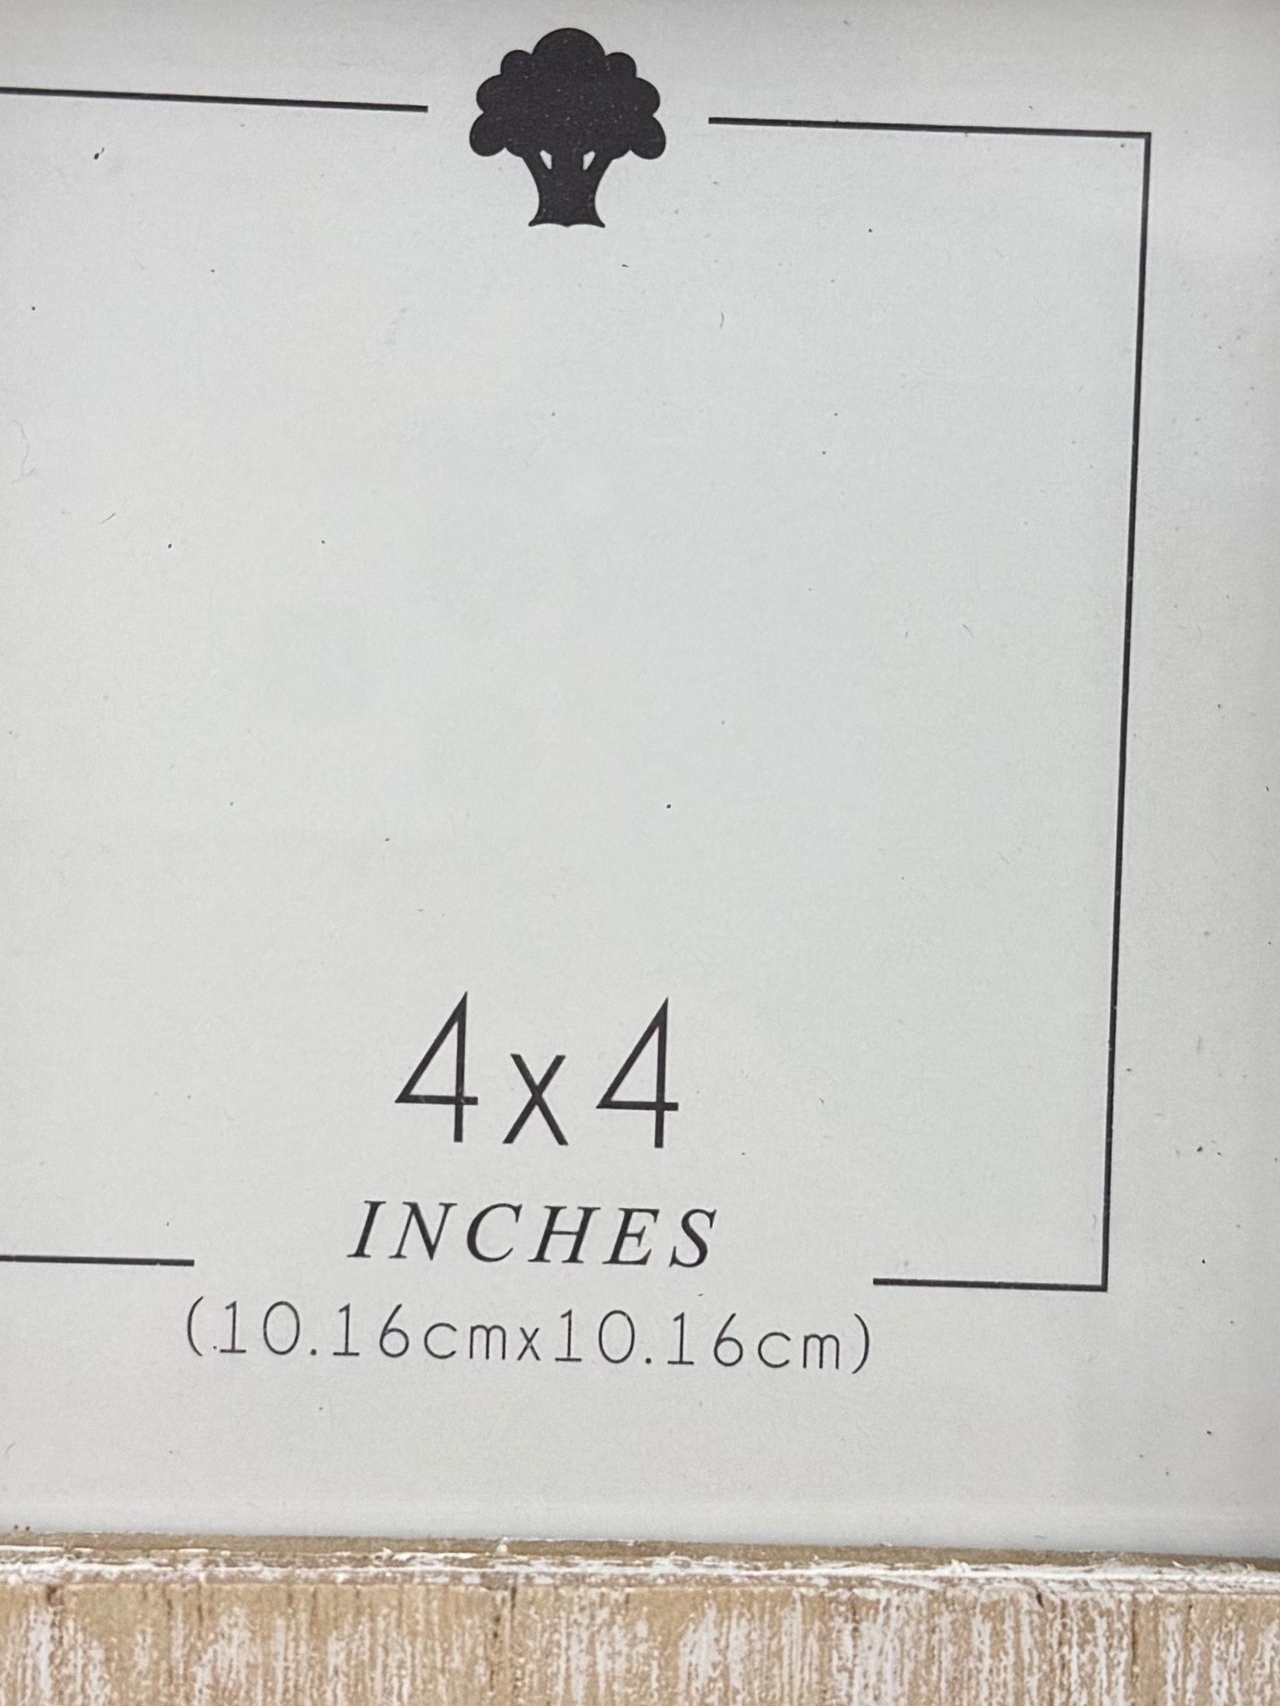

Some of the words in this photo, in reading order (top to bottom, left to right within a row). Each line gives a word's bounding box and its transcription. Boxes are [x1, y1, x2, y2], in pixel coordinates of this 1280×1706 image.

[395, 991, 679, 1149] 4x4
[347, 1199, 718, 1269] INCHES
[186, 1296, 872, 1375] (10.16cmx10.16cm)
